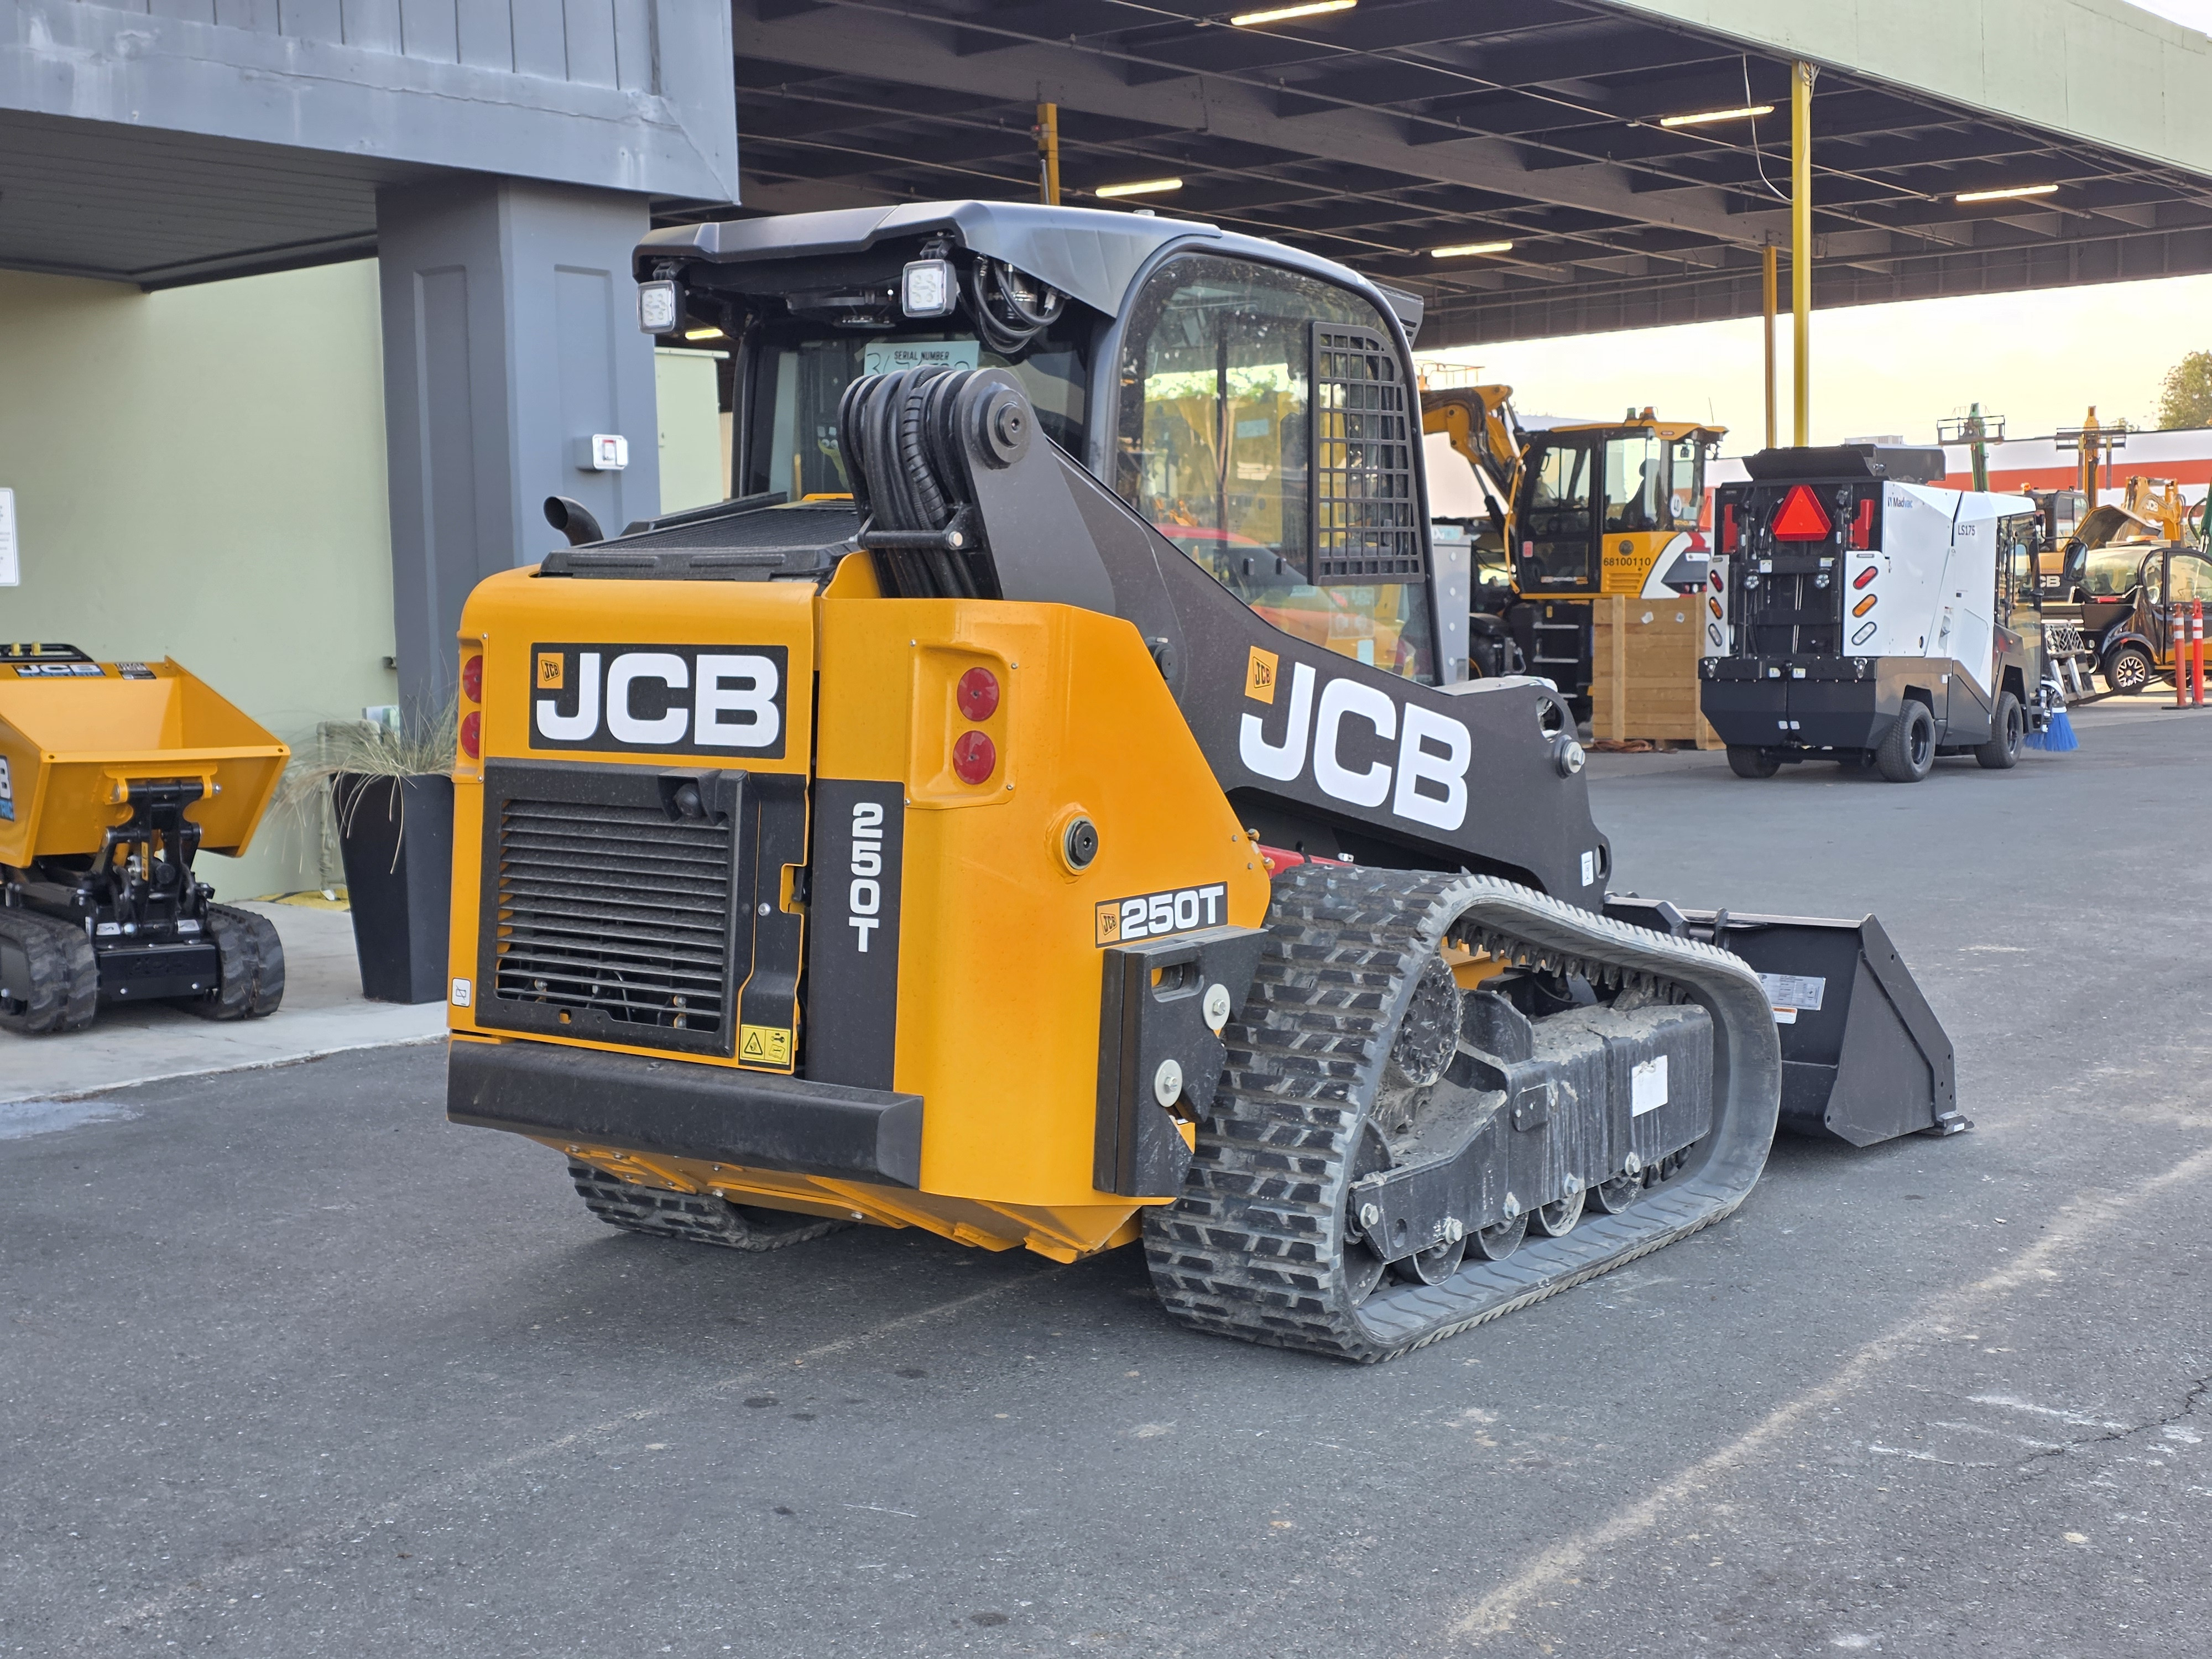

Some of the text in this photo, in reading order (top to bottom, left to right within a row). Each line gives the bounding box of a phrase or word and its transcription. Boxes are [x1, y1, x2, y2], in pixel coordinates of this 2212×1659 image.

[894, 351, 950, 360] SERIAL NUMBER
[1893, 497, 1913, 508] Madvac
[1958, 525, 1975, 536] LS175
[1604, 557, 1651, 566] 68100110
[17, 664, 101, 674] JCB
[545, 662, 559, 679] JCB
[1255, 661, 1270, 685] JCB
[537, 653, 780, 747] JCB
[1239, 662, 1472, 831] JCB
[849, 802, 883, 952] 250T
[1121, 885, 1224, 940] 250T
[1103, 915, 1116, 933] JCB
